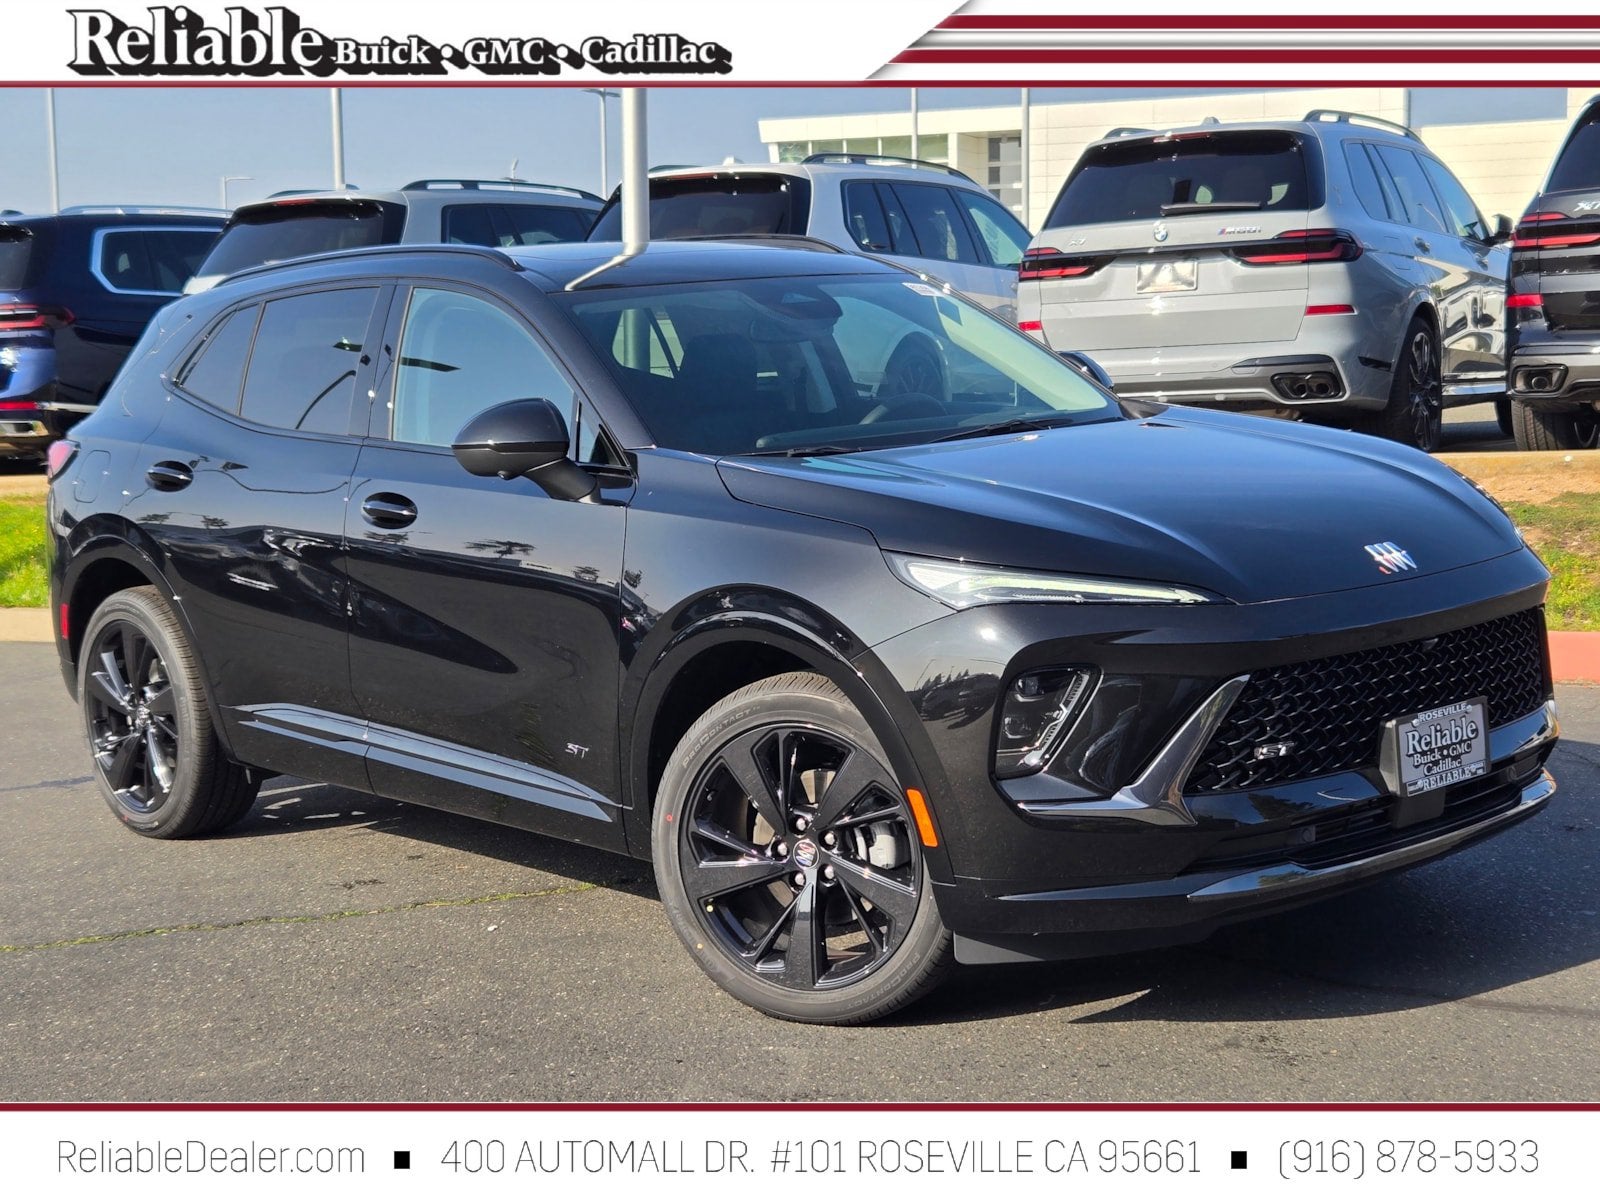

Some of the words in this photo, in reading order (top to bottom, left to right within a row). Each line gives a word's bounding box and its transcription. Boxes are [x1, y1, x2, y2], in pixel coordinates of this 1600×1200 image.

[1419, 702, 1467, 722] ROSEVILLE
[1407, 716, 1478, 755] Reliable
[1413, 750, 1442, 767] Buick
[1449, 741, 1471, 756] GMC
[1423, 758, 1462, 776] Cadillac
[1422, 766, 1472, 792] RELIABLE
